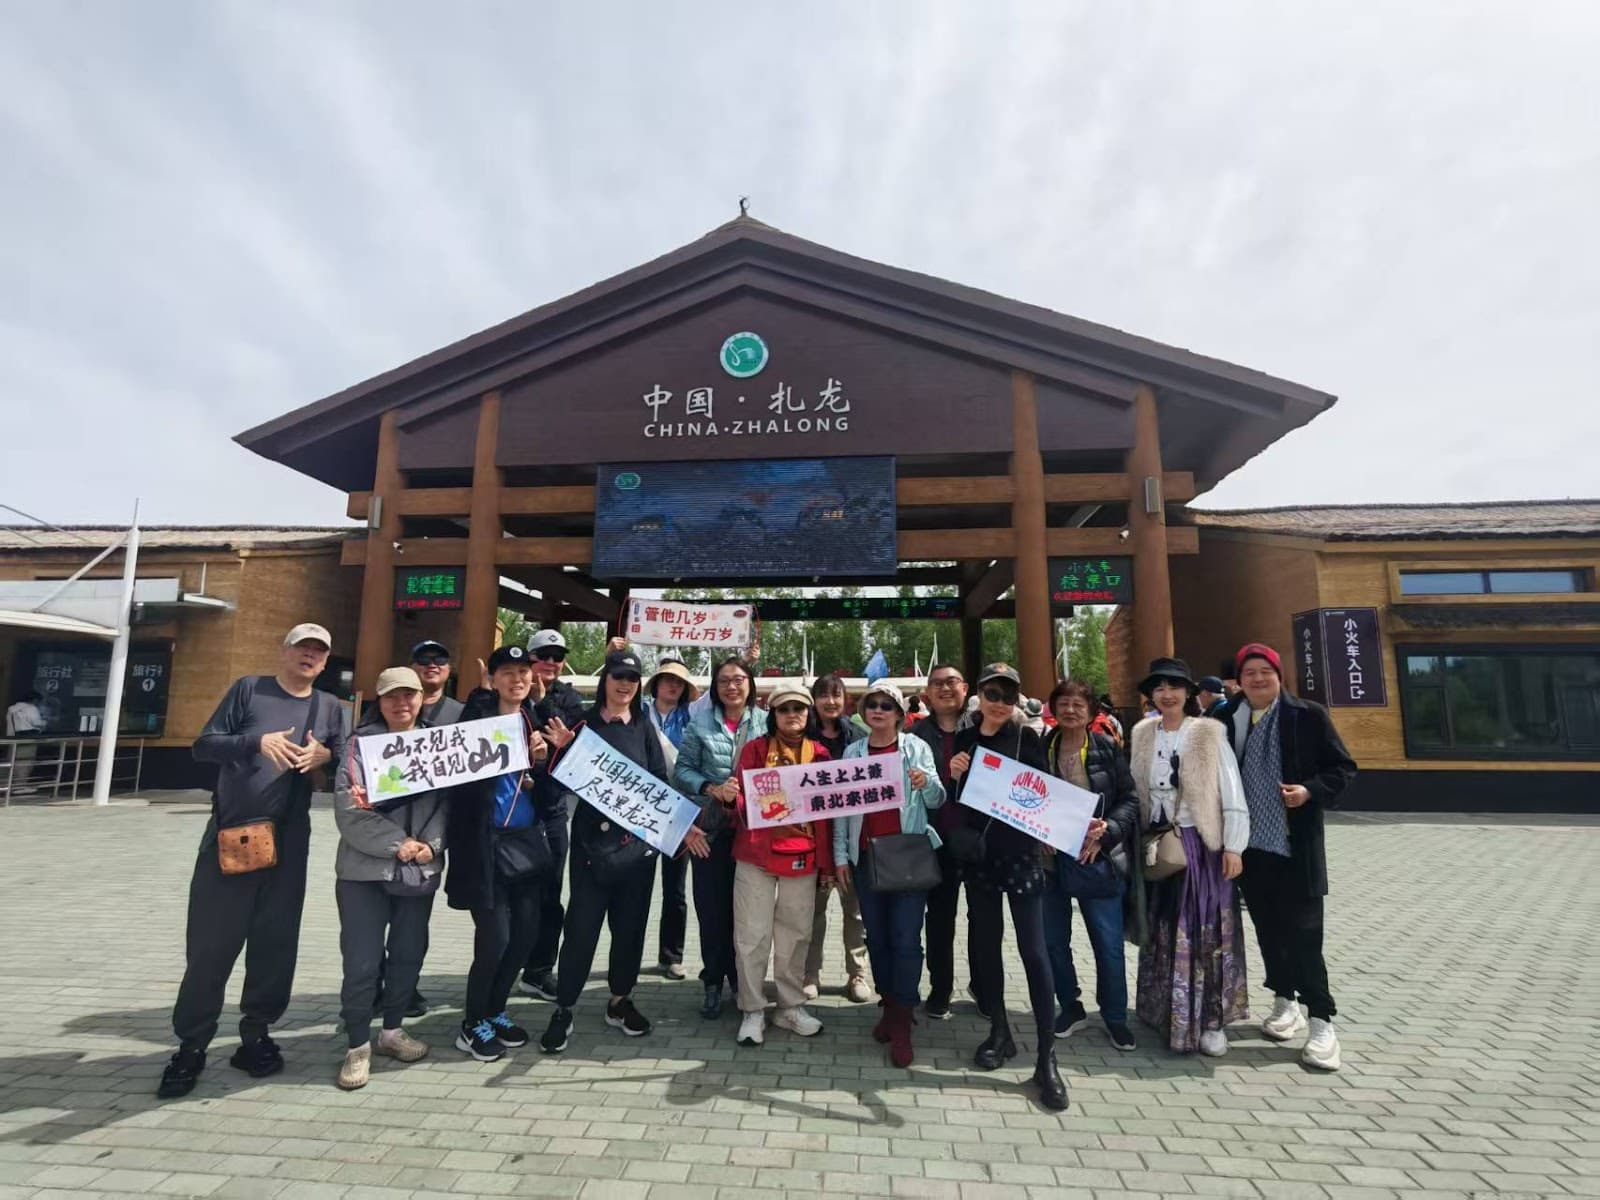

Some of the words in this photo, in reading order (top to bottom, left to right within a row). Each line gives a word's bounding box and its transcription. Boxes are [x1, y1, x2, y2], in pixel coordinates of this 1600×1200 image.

[645, 606, 707, 625] 管他几岁
[670, 627, 732, 640] 开心万岁
[1343, 618, 1363, 684] 小火车入口
[382, 726, 469, 760] 山不见我
[401, 738, 510, 787] 我自见山
[575, 776, 660, 834] 尽在黑龙江
[590, 752, 672, 814] 北国好风光
